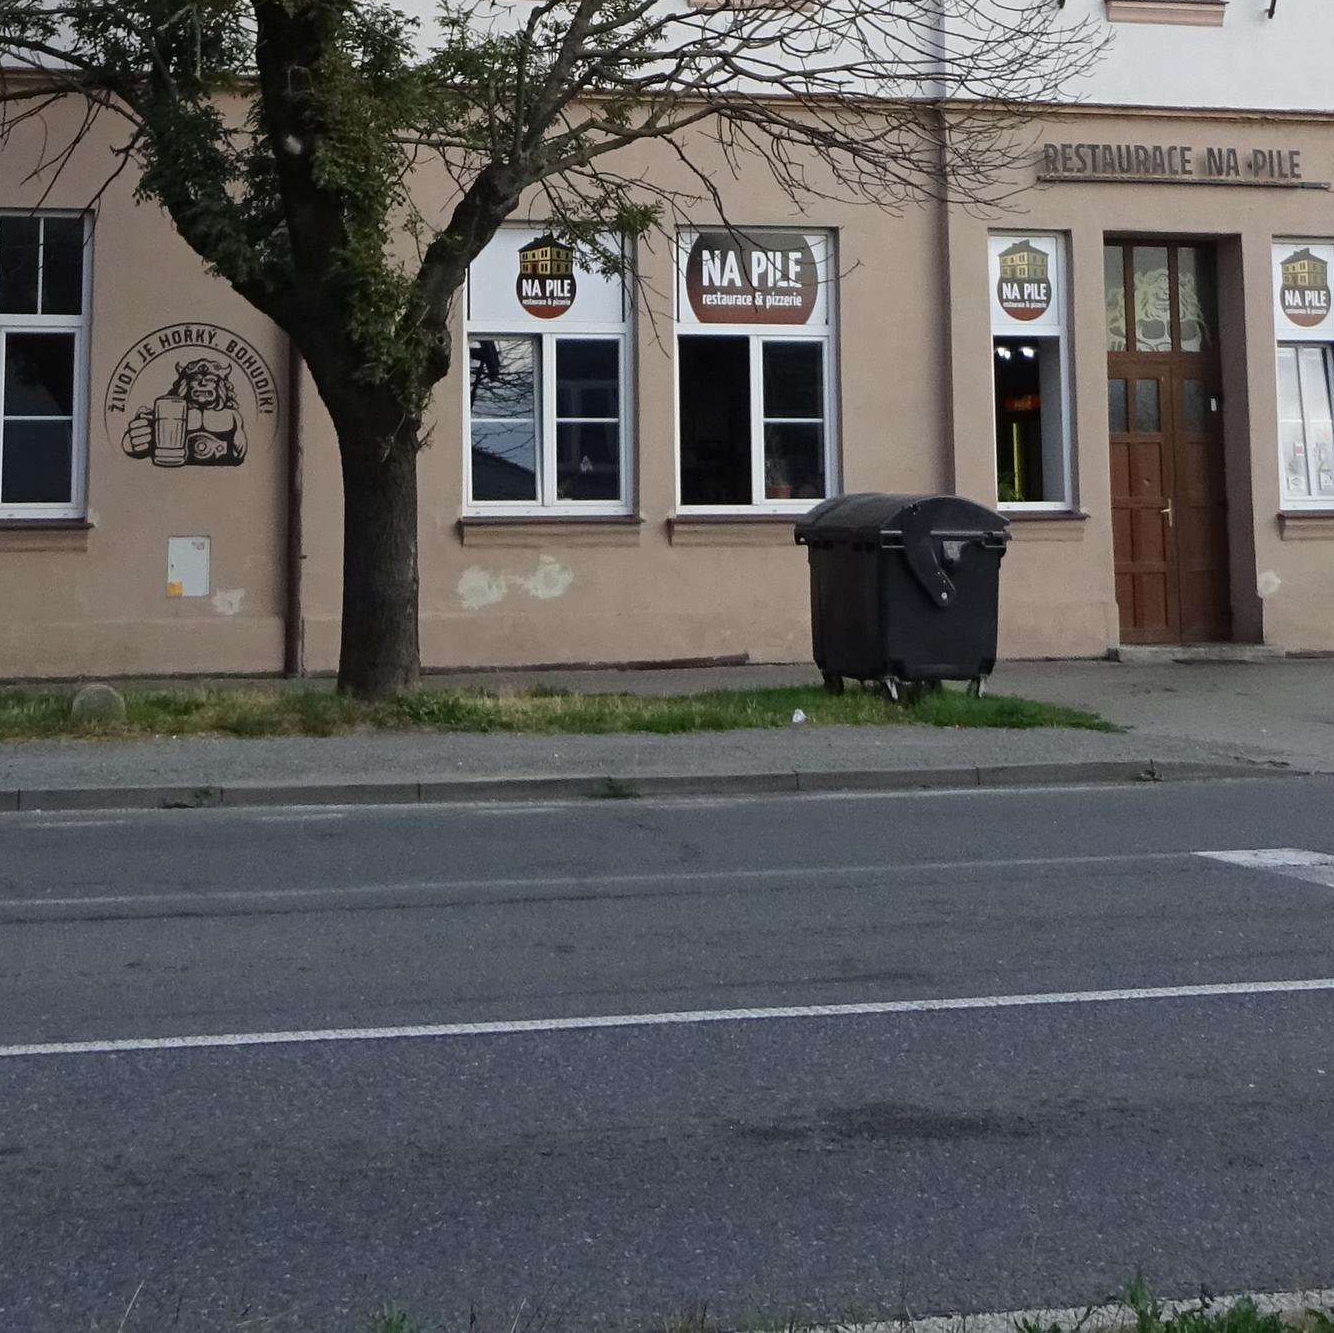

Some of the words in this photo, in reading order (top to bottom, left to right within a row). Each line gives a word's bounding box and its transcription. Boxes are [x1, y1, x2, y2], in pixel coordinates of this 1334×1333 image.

[1044, 144, 1193, 175] RESTAURACE
[1206, 147, 1240, 177] NA
[1251, 149, 1302, 179] PILE
[702, 250, 742, 287] NA
[751, 251, 803, 288] PILE
[522, 279, 542, 297] NA
[546, 279, 571, 297] PILE
[1002, 282, 1021, 300] NA
[1023, 282, 1047, 300] PILE
[702, 292, 752, 305] restaurace
[755, 291, 763, 305] &
[765, 291, 803, 309] pizzerie
[1284, 289, 1302, 307] NA
[1304, 290, 1327, 307] PILE
[108, 361, 138, 413] ŽIVOT
[136, 342, 157, 363] JE
[158, 327, 220, 350] HOŘKÝ.
[225, 338, 274, 415] BOHUDÍK!
